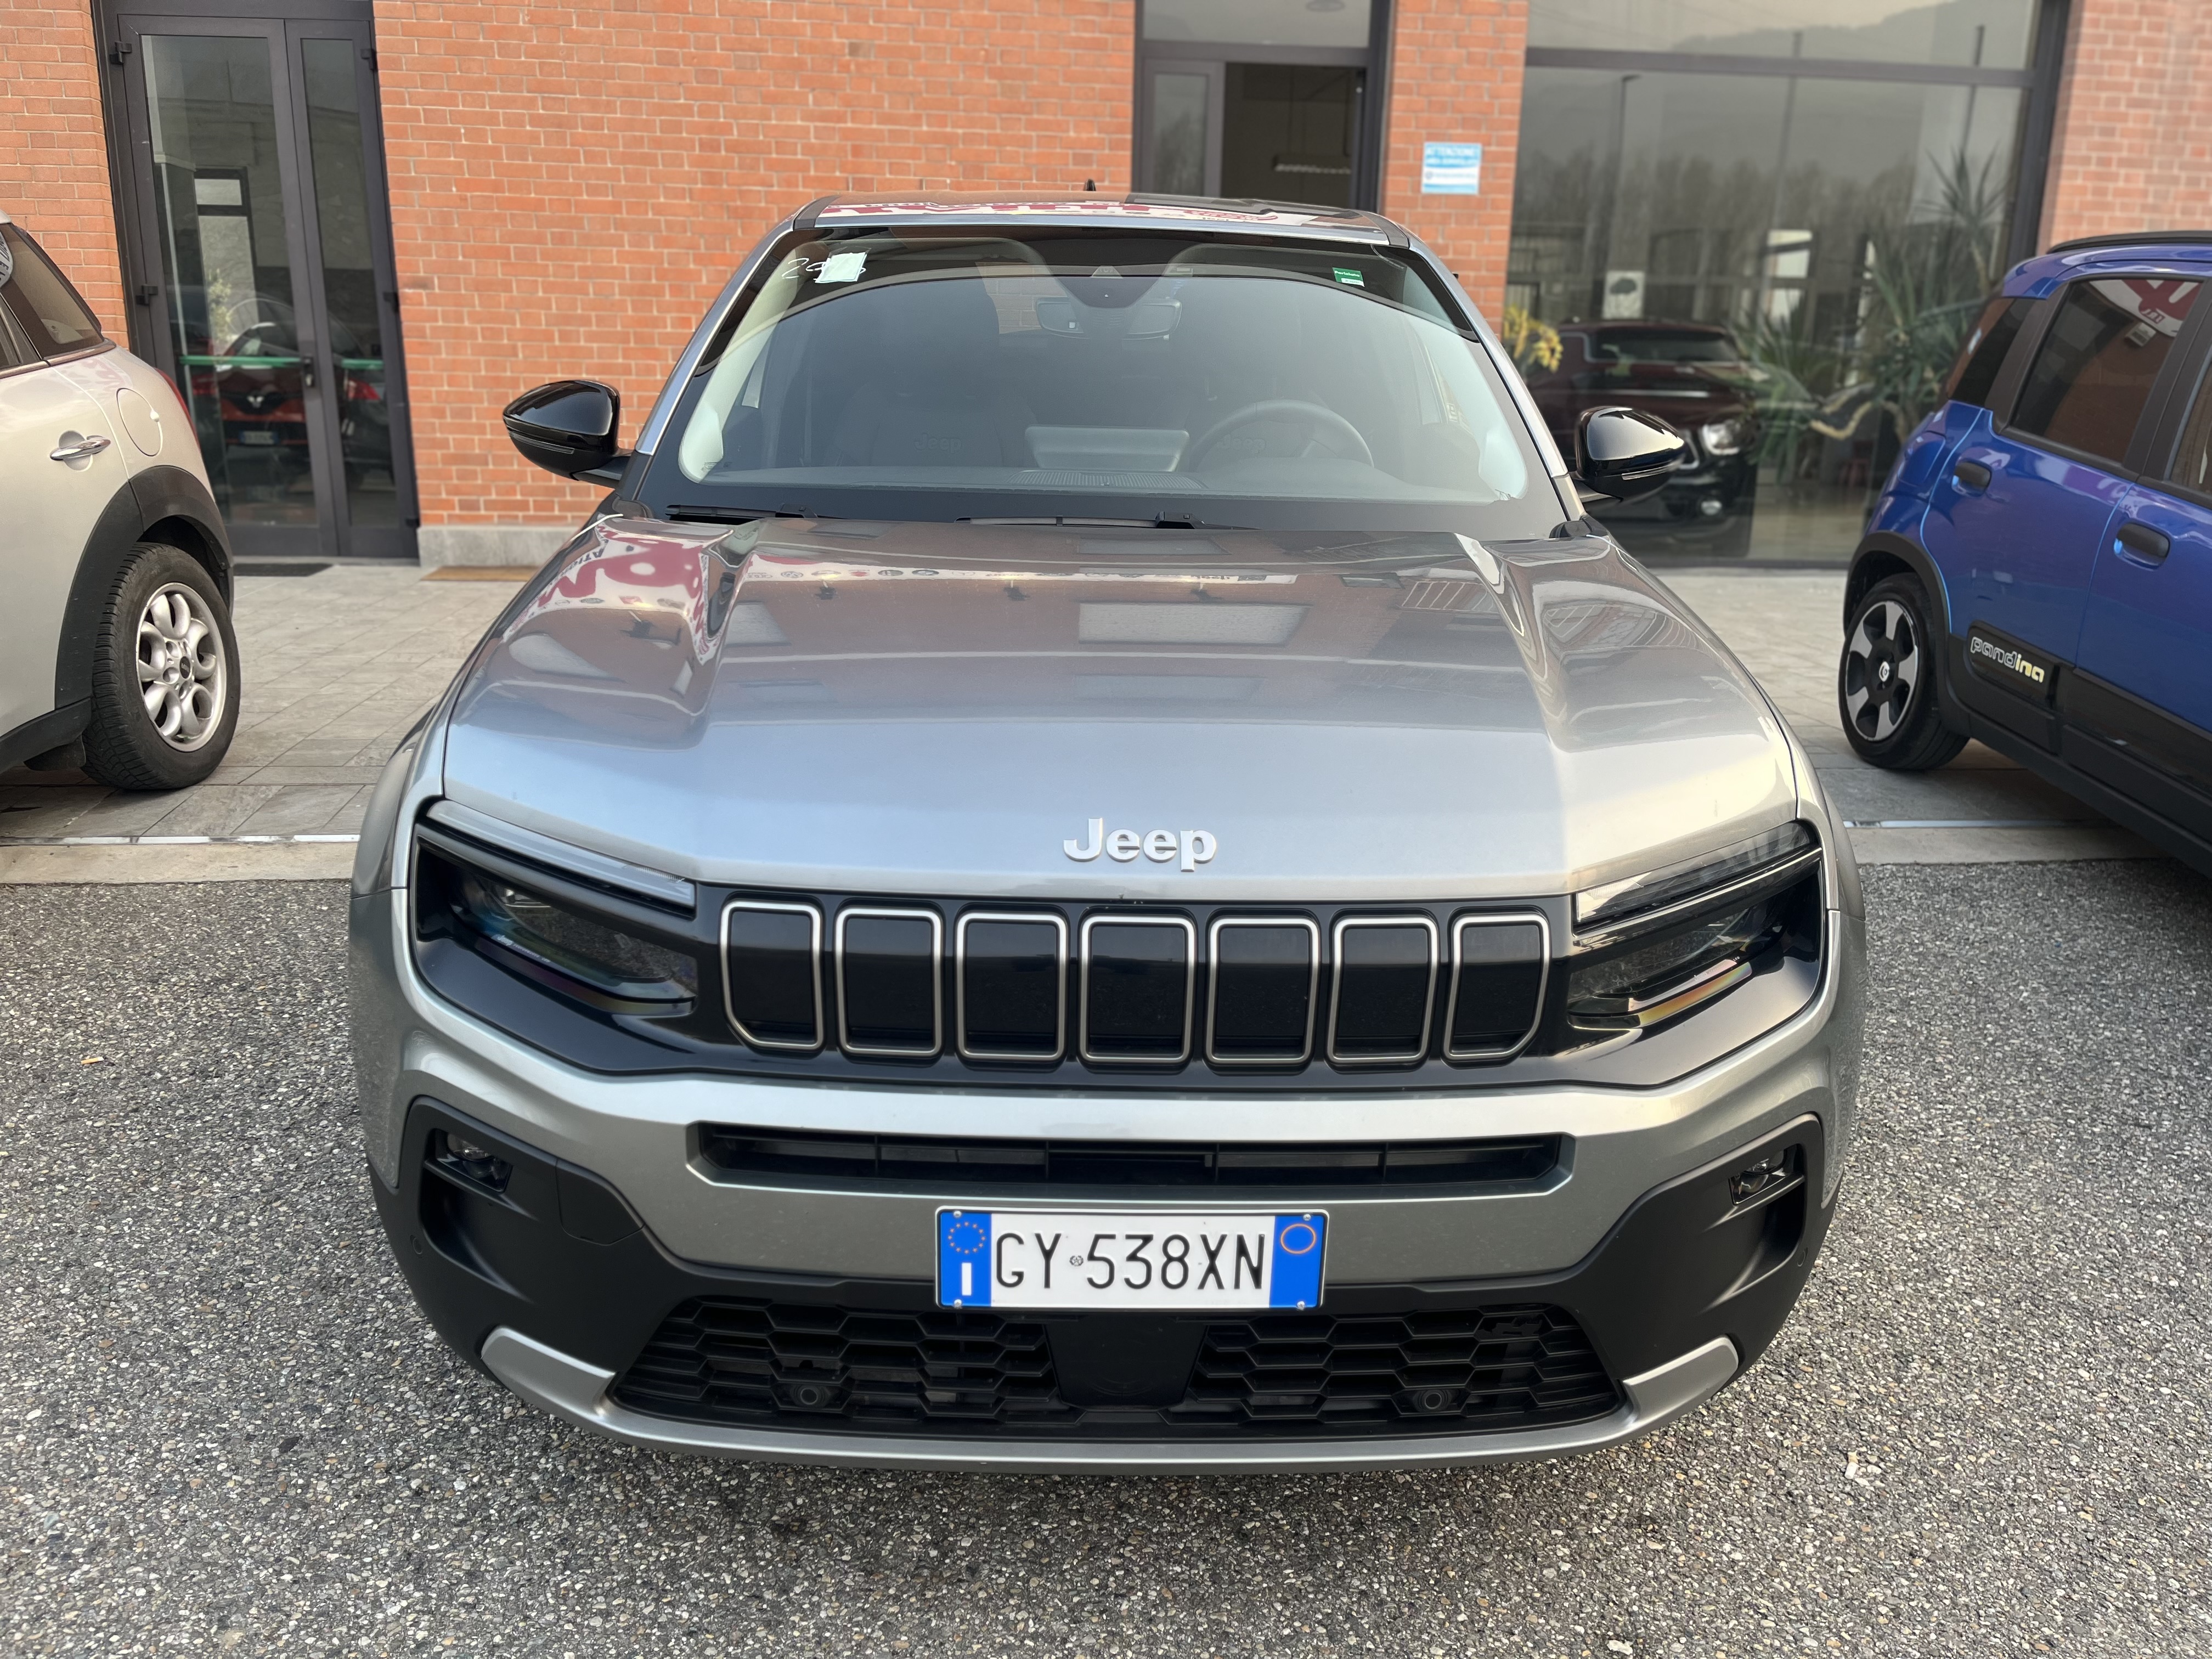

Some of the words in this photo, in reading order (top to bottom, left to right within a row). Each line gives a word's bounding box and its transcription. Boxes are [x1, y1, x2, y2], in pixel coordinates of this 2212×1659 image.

[913, 433, 962, 454] Jeep
[1970, 636, 2045, 683] pandina
[1063, 817, 1217, 872] Jeep
[1087, 1234, 1265, 1290] 538XN
